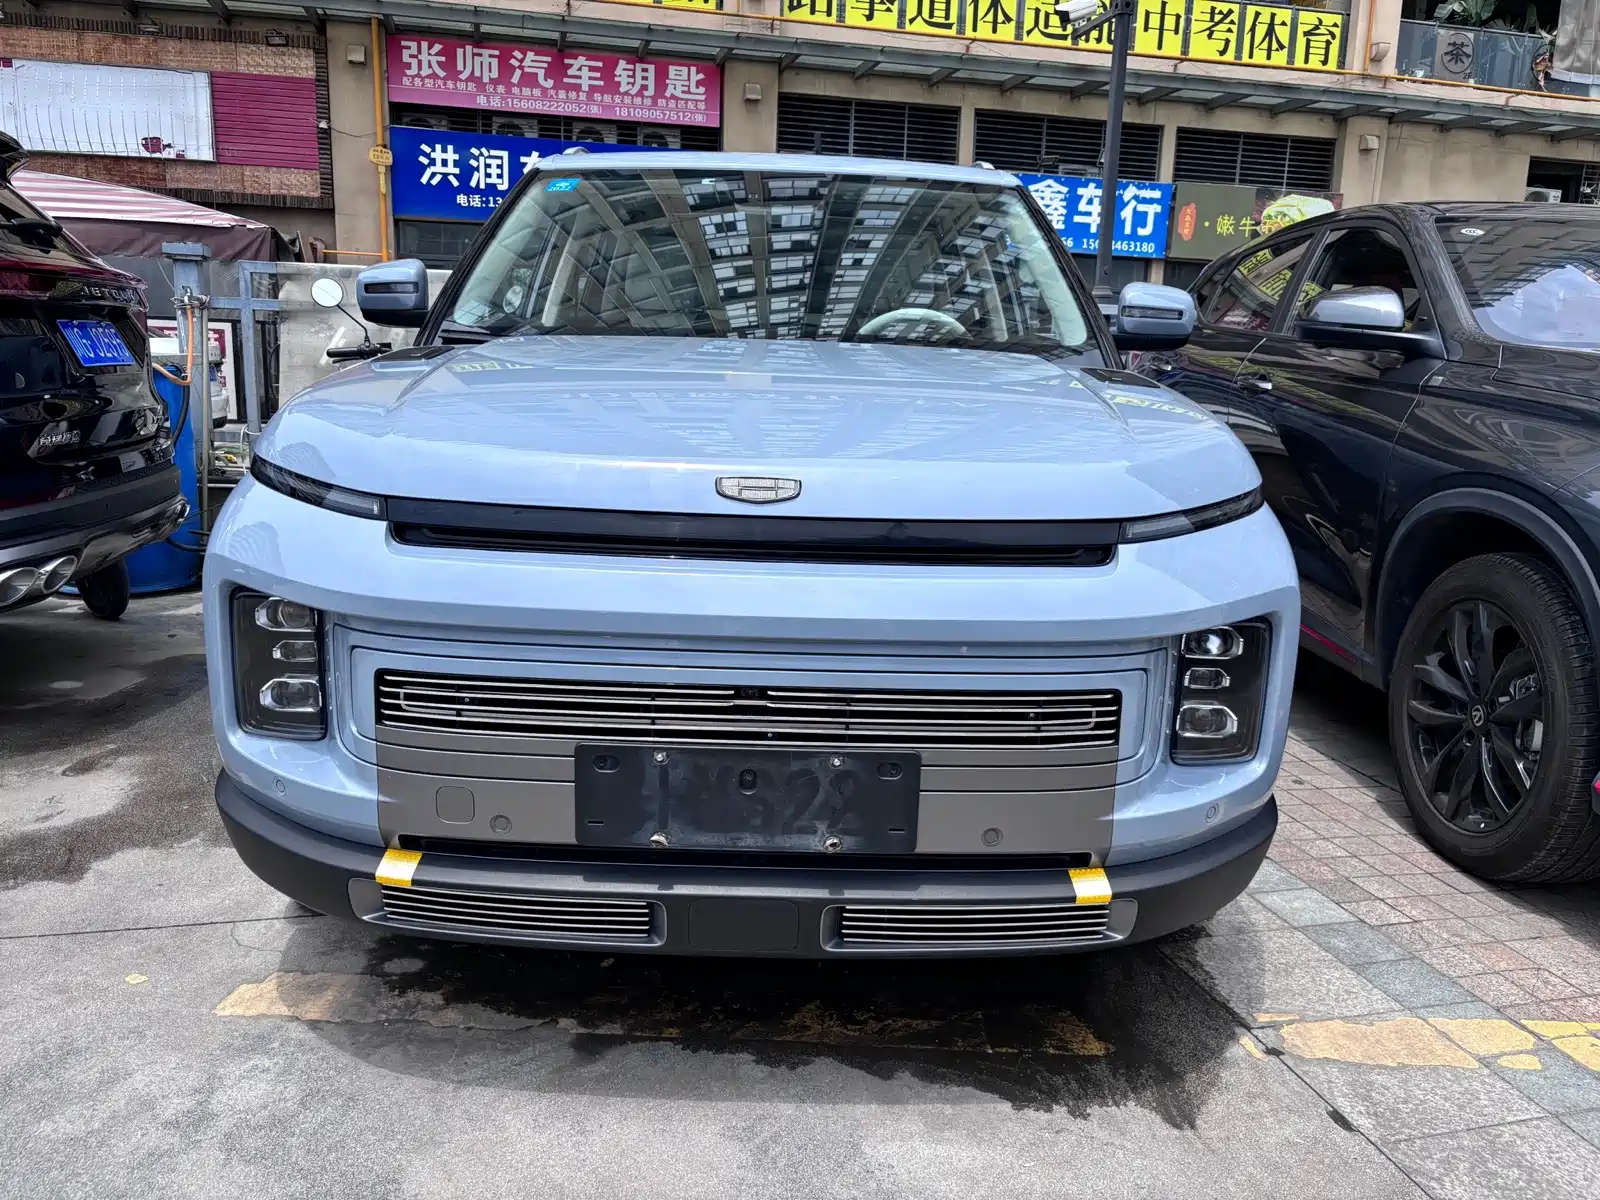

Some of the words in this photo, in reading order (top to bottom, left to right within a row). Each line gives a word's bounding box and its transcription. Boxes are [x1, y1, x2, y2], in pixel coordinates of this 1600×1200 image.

[1444, 41, 1471, 65] 茶
[401, 40, 707, 100] 张师汽车钥匙
[402, 76, 477, 92] 配各型汽车钥匙
[485, 83, 506, 94] 仪表
[511, 86, 542, 97] 电脑板
[593, 93, 653, 106] 导航安装维修
[657, 98, 706, 111] 防盗匹配等
[614, 106, 707, 123] 18109057512(张)
[1027, 178, 1162, 236] 鑫车行
[1082, 238, 1155, 253] 15463180
